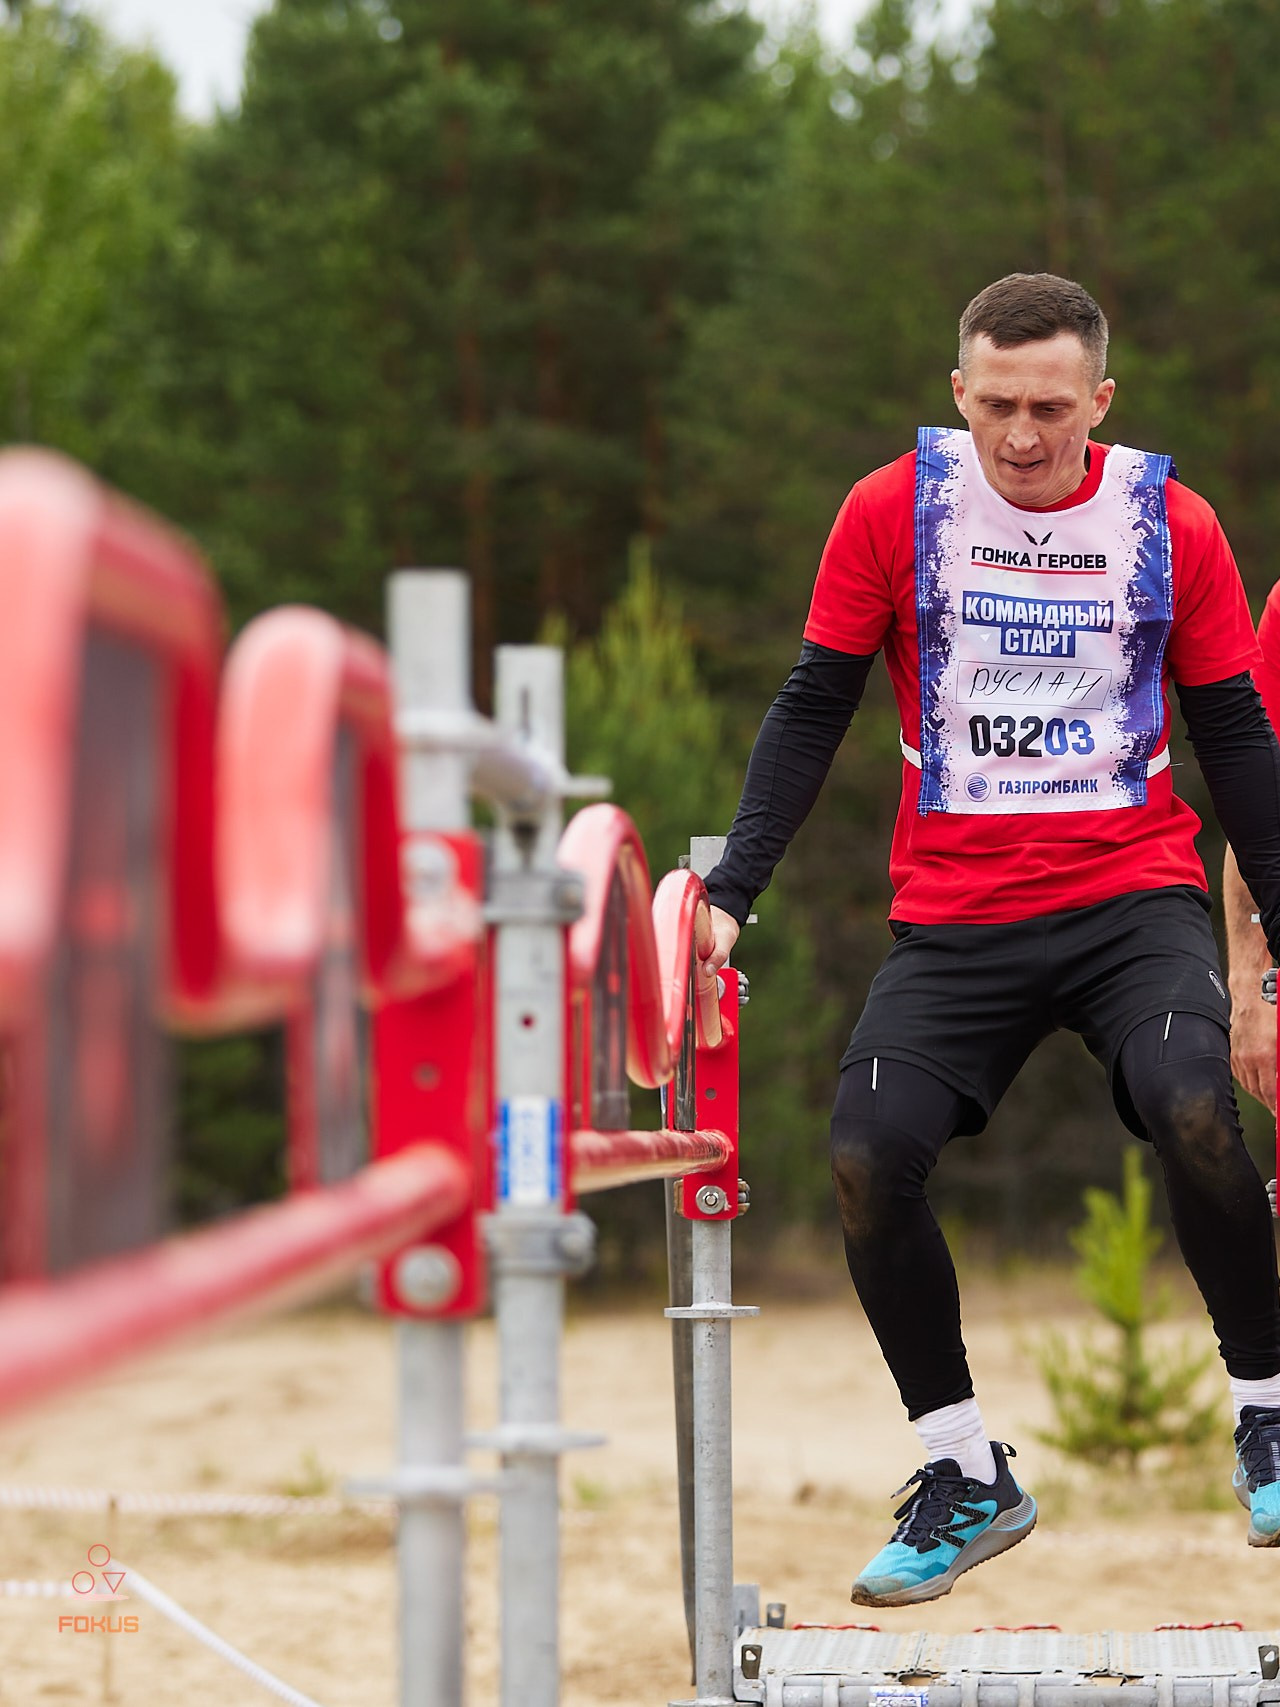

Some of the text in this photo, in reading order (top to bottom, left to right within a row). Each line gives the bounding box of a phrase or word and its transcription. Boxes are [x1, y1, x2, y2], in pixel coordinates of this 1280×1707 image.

[971, 546, 1107, 569] ГОНКА ГЕРОЕВ
[965, 597, 1113, 629] КОМАНДНЫЙ
[1005, 629, 1072, 655] СТАРТ
[969, 668, 1103, 701] РУСЛАН
[968, 715, 1095, 757] 03203
[998, 778, 1099, 794] ГАЗПРОМБАНК
